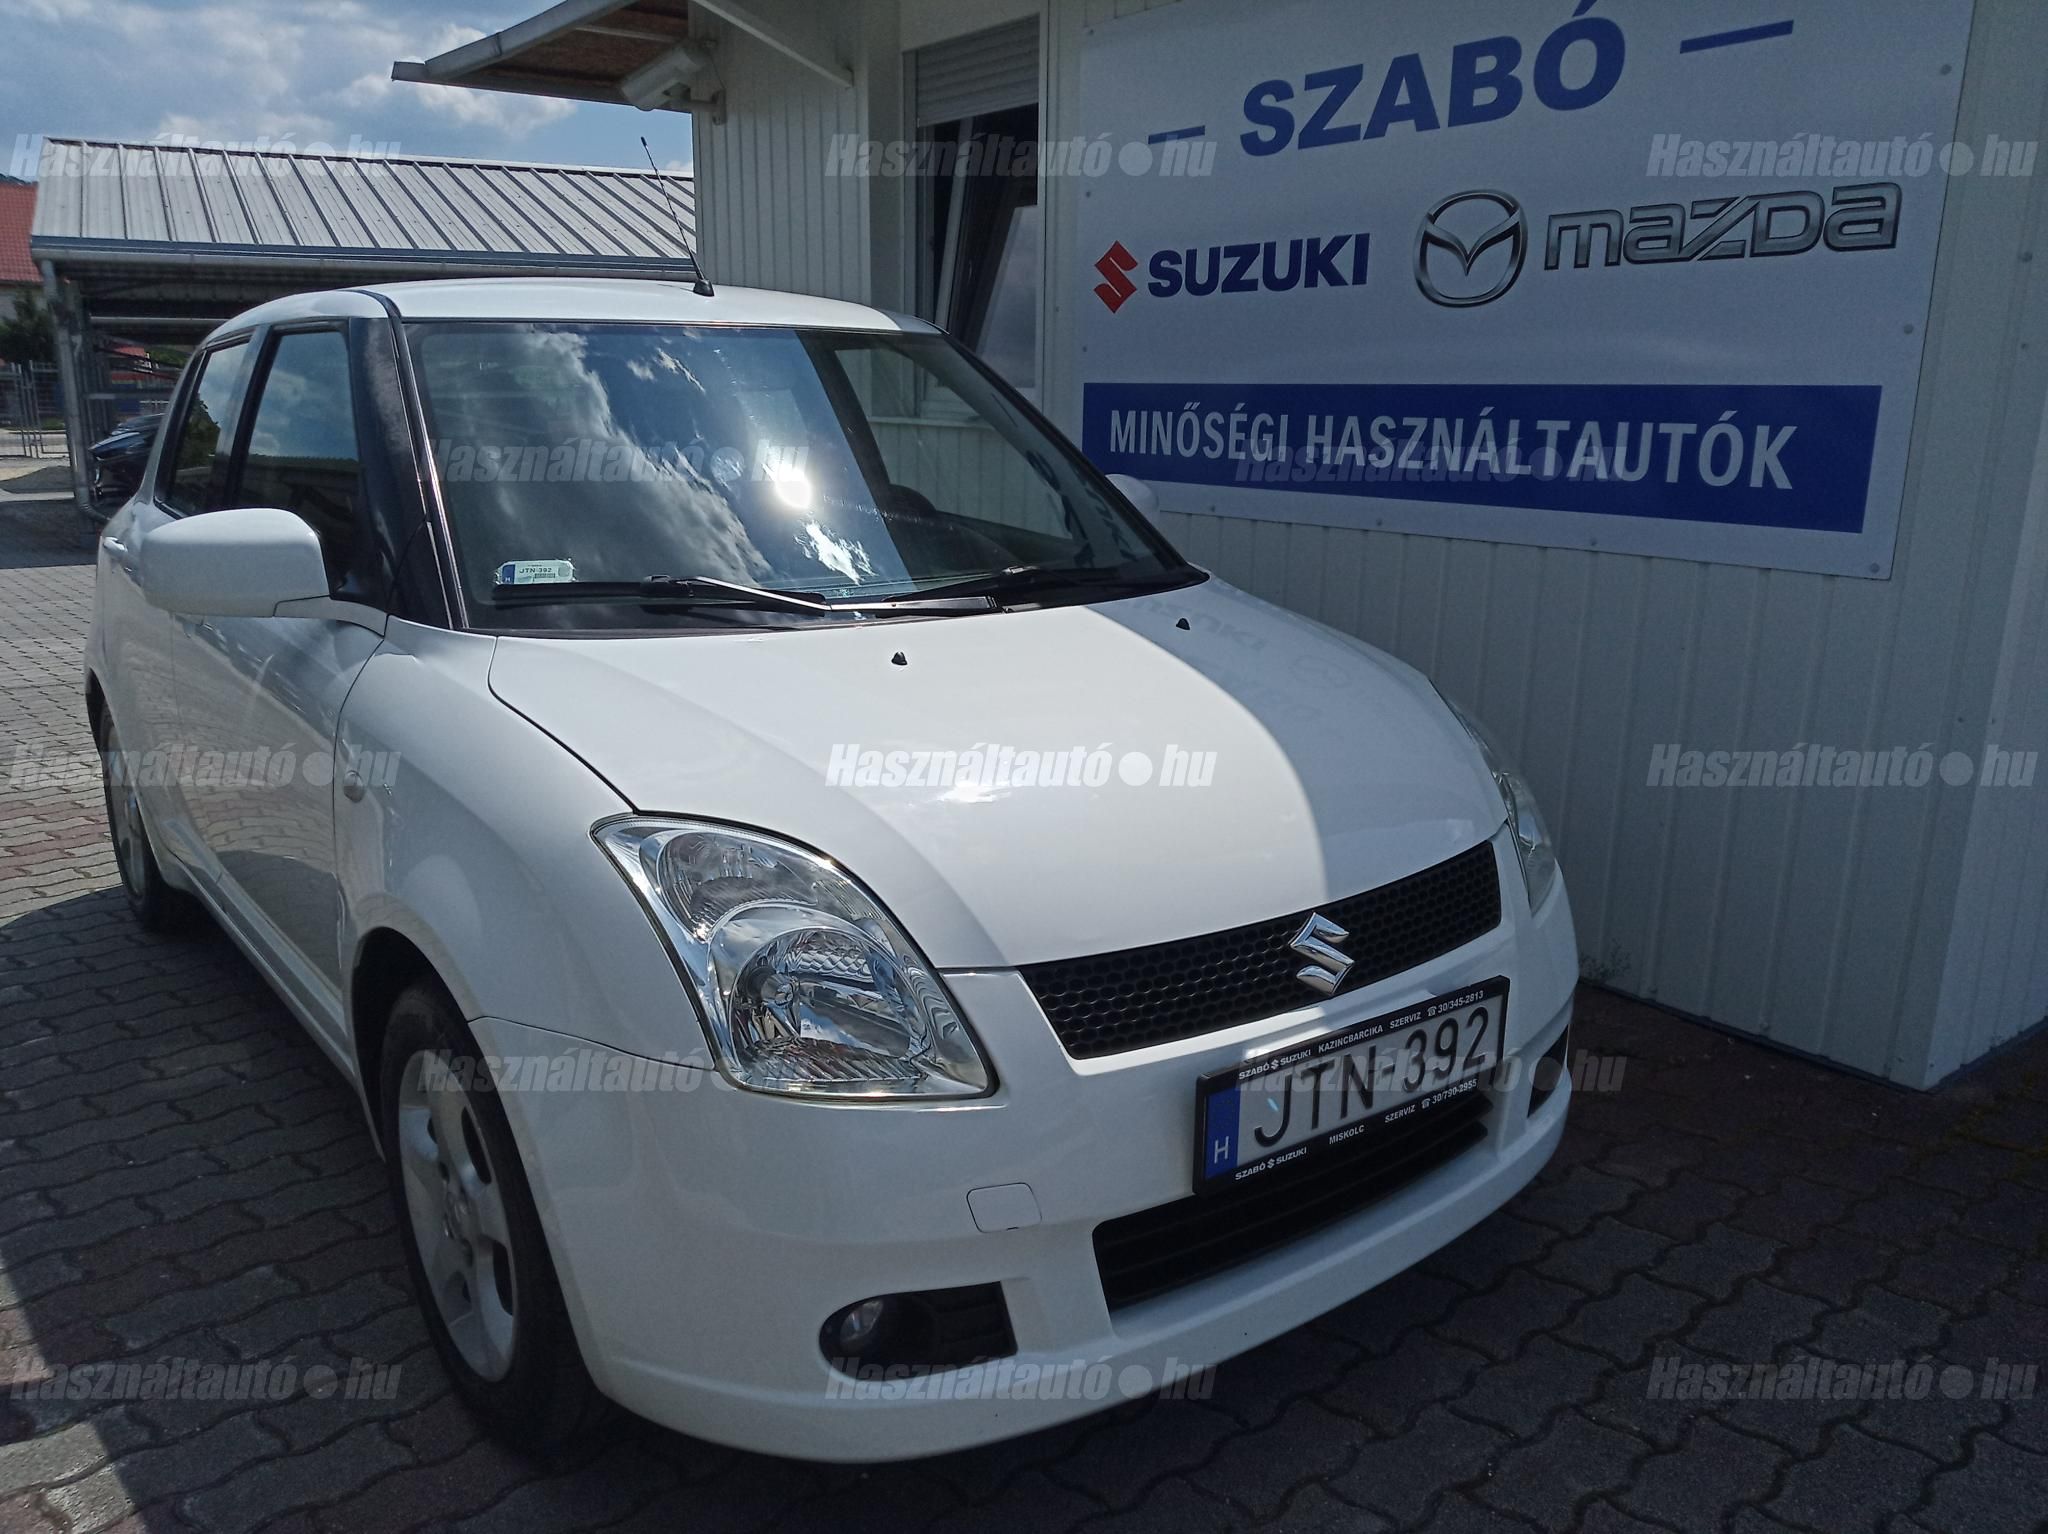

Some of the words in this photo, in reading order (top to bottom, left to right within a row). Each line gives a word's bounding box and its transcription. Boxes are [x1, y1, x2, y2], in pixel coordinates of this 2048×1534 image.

[1240, 0, 1626, 157] SZABÓ
[1148, 232, 1370, 298] SUZUKI
[1109, 401, 1289, 464] MINŐSÉGI
[1305, 409, 1798, 490] HASZNÁLTAUTÓK
[1238, 1060, 1270, 1080] SZABÓ
[1280, 1049, 1311, 1066] SUZUKI
[1318, 1024, 1384, 1053] KAZINCBARCIKA
[1389, 1011, 1422, 1030] SZERVIZ
[1254, 1006, 1490, 1148] JTN-392
[1213, 1136, 1230, 1164] H
[1235, 1161, 1266, 1181] SZABÓ
[1275, 1146, 1307, 1165] SUZUKI
[1329, 1124, 1365, 1145] MISKOLC
[1384, 1104, 1416, 1123] SZERVIZ
